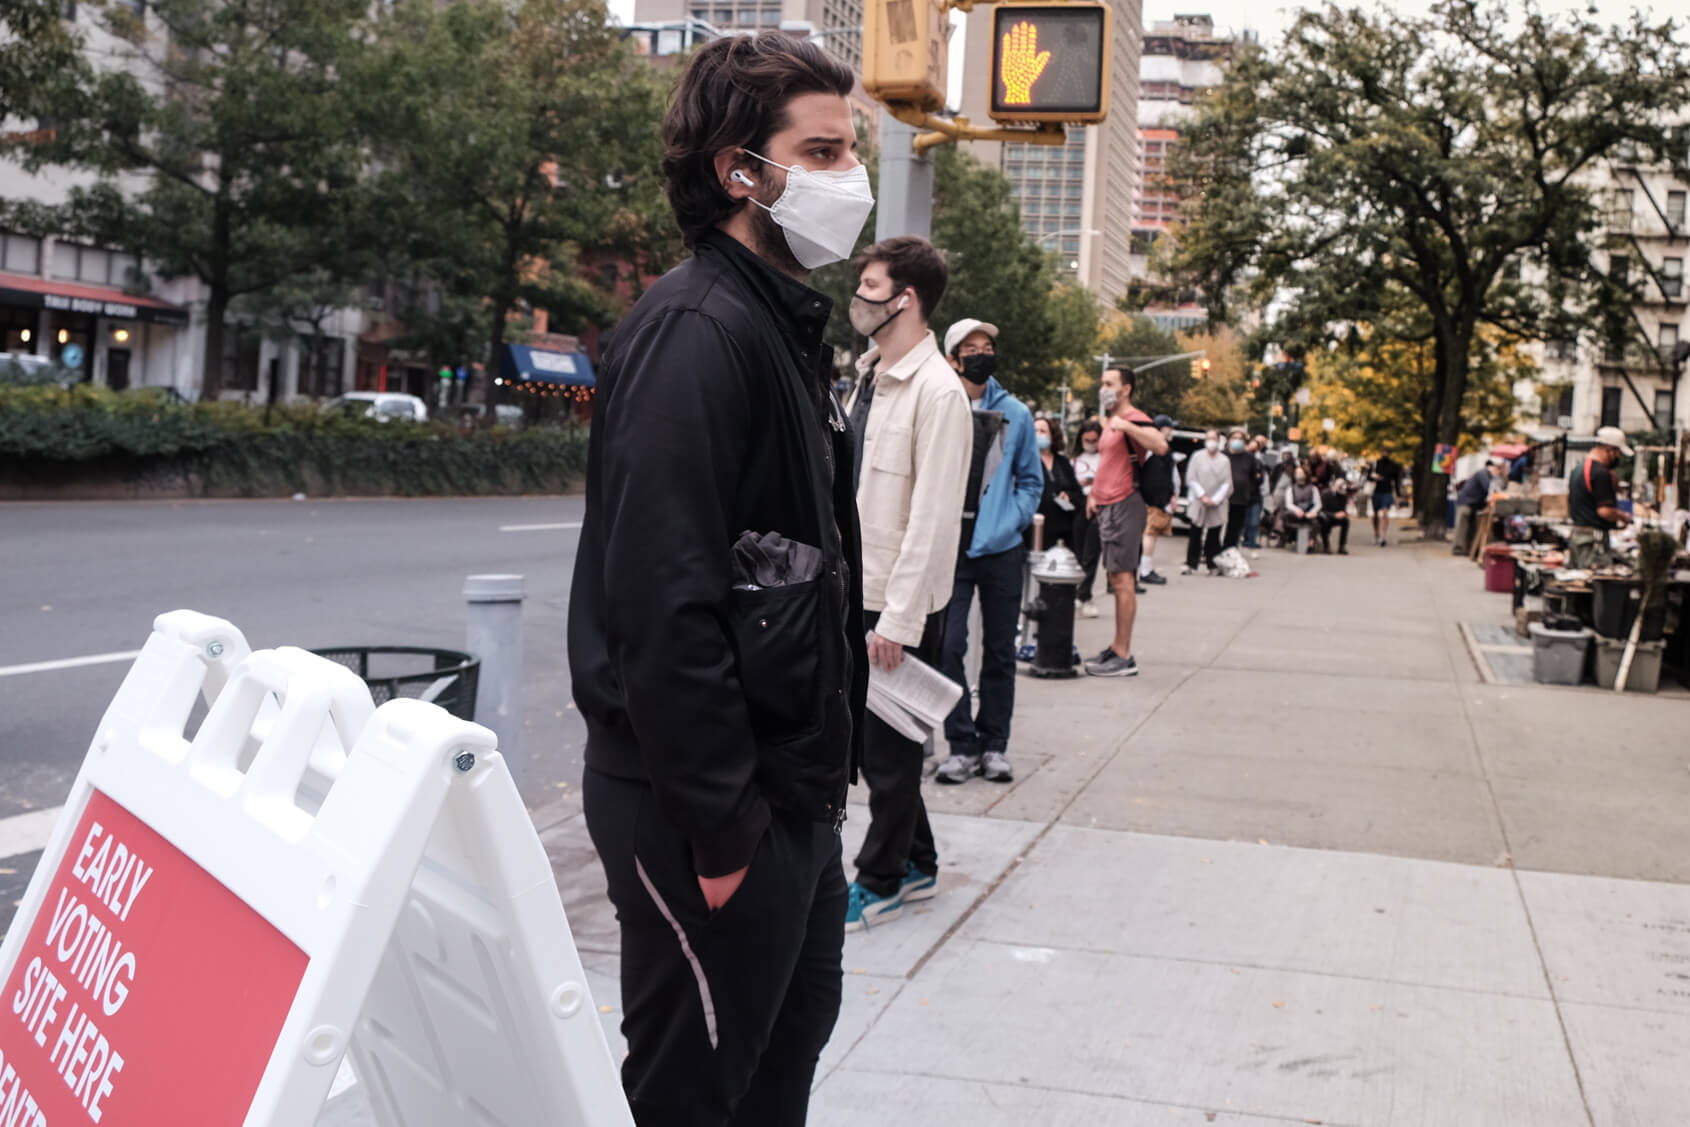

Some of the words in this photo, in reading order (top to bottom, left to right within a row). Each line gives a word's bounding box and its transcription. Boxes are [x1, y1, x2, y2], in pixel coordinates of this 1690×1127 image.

[71, 821, 154, 922] EARLY
[45, 886, 136, 1017] VOTING
[12, 956, 68, 1048] SITE
[49, 1002, 125, 1125] HERE
